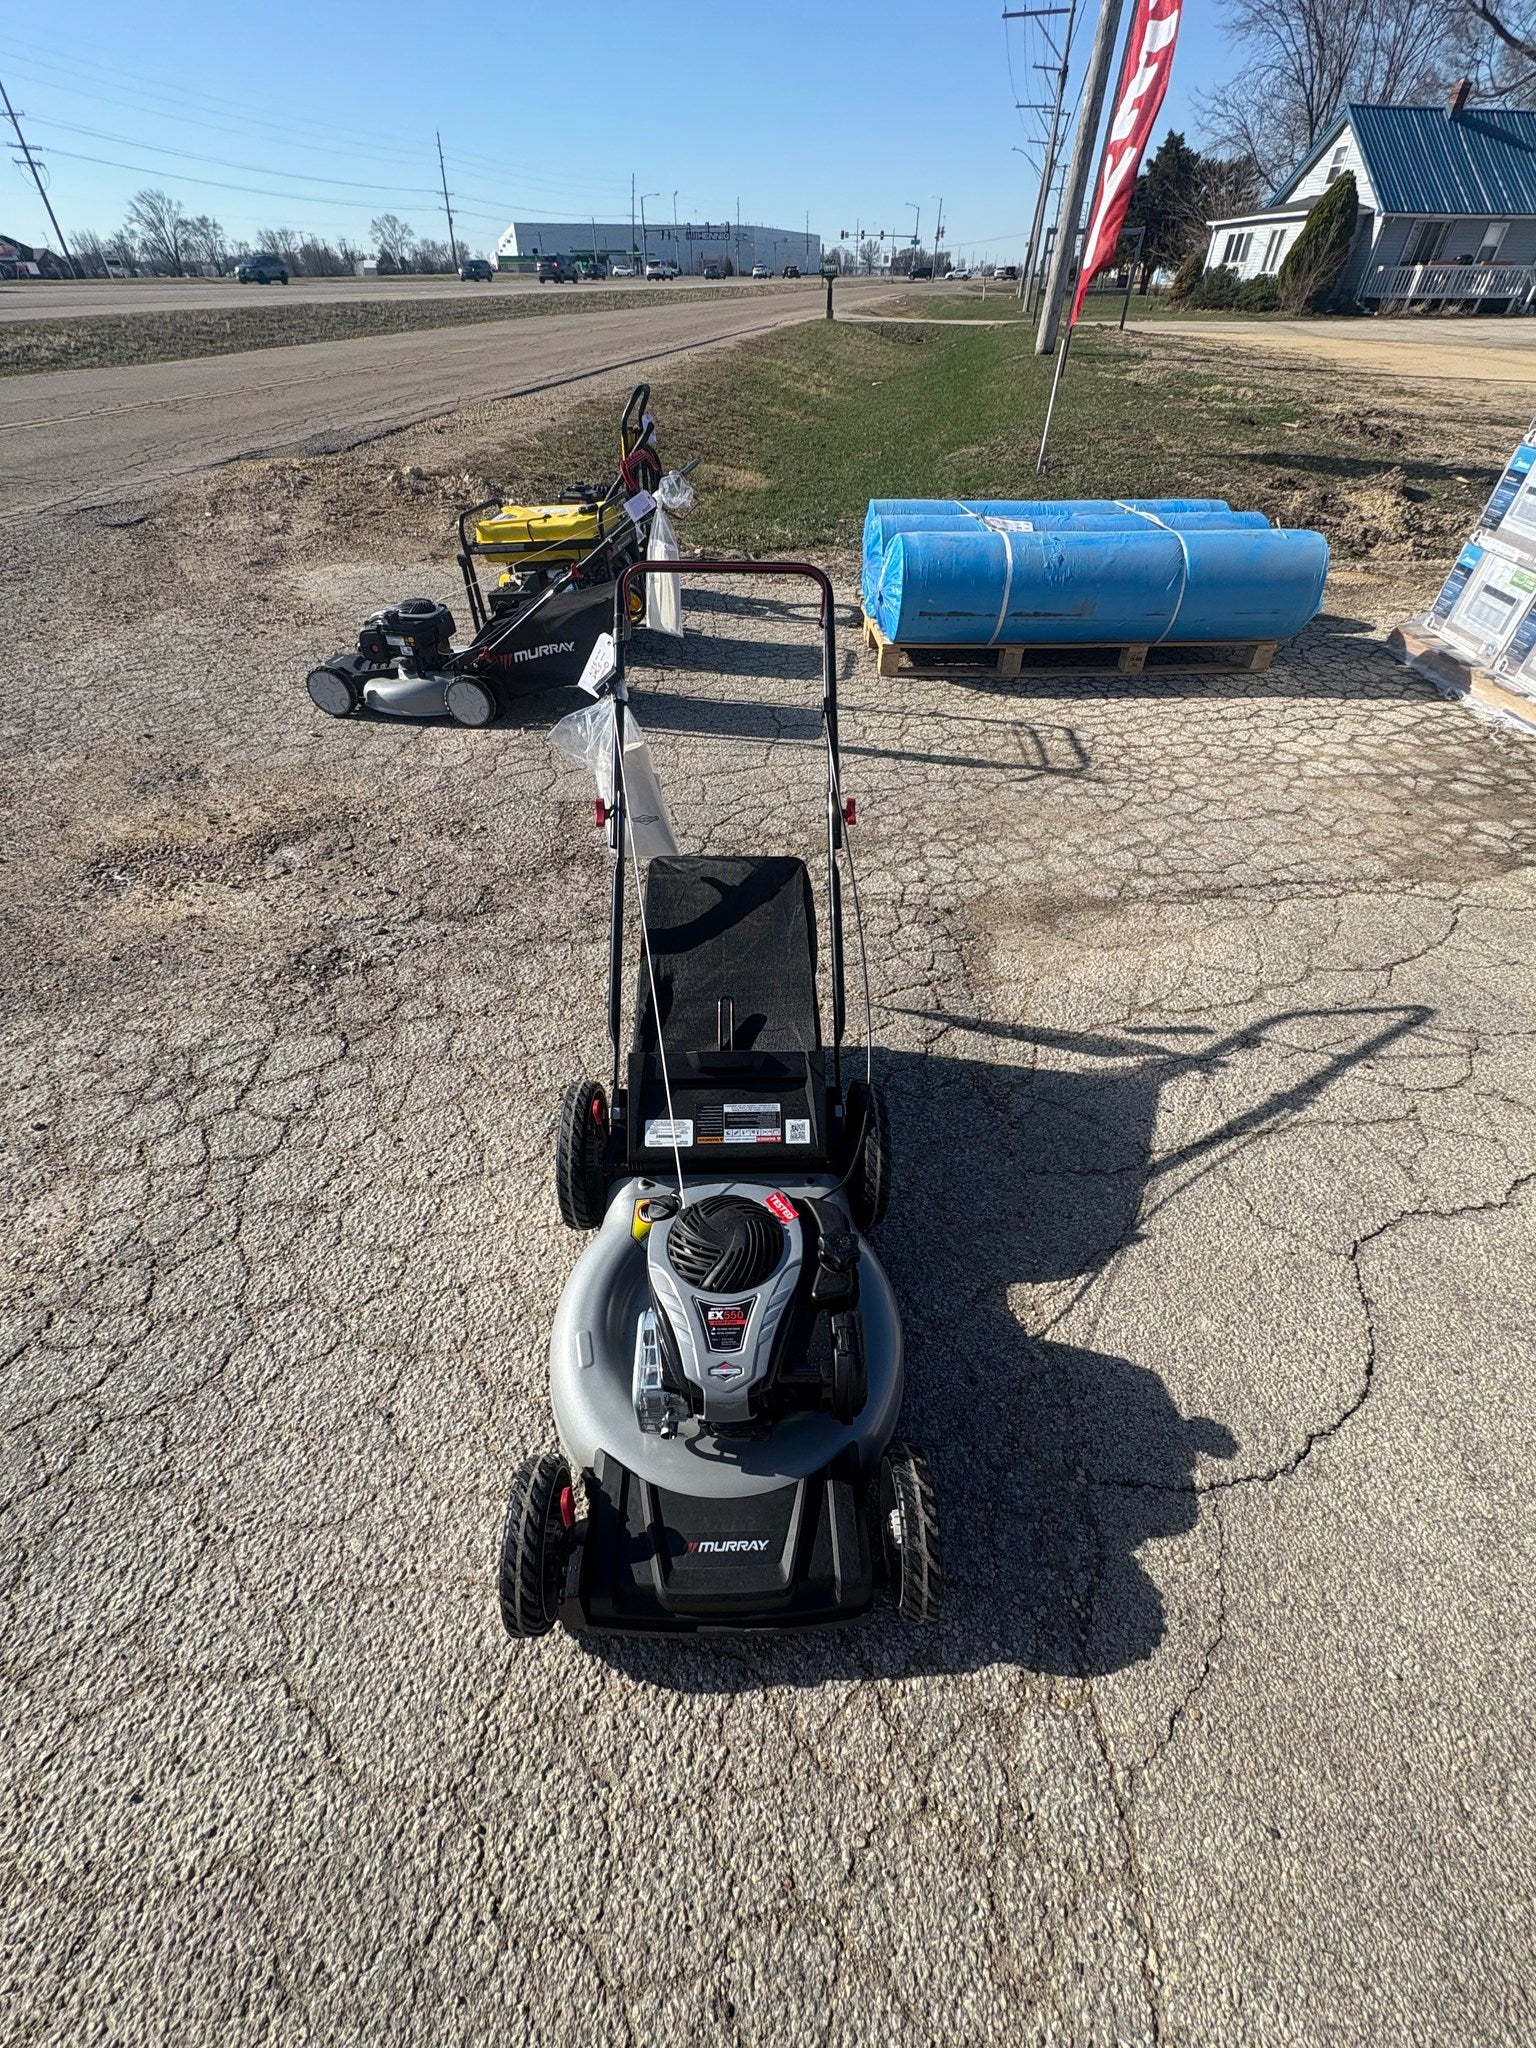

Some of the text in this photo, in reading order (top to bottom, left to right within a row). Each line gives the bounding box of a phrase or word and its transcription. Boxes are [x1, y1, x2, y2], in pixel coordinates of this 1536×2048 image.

[698, 232, 730, 240] HENNIG
[513, 641, 576, 663] MURRAY
[769, 1194, 795, 1221] TESTED
[707, 1310, 744, 1320] EX550
[698, 1540, 770, 1552] MURRAY
